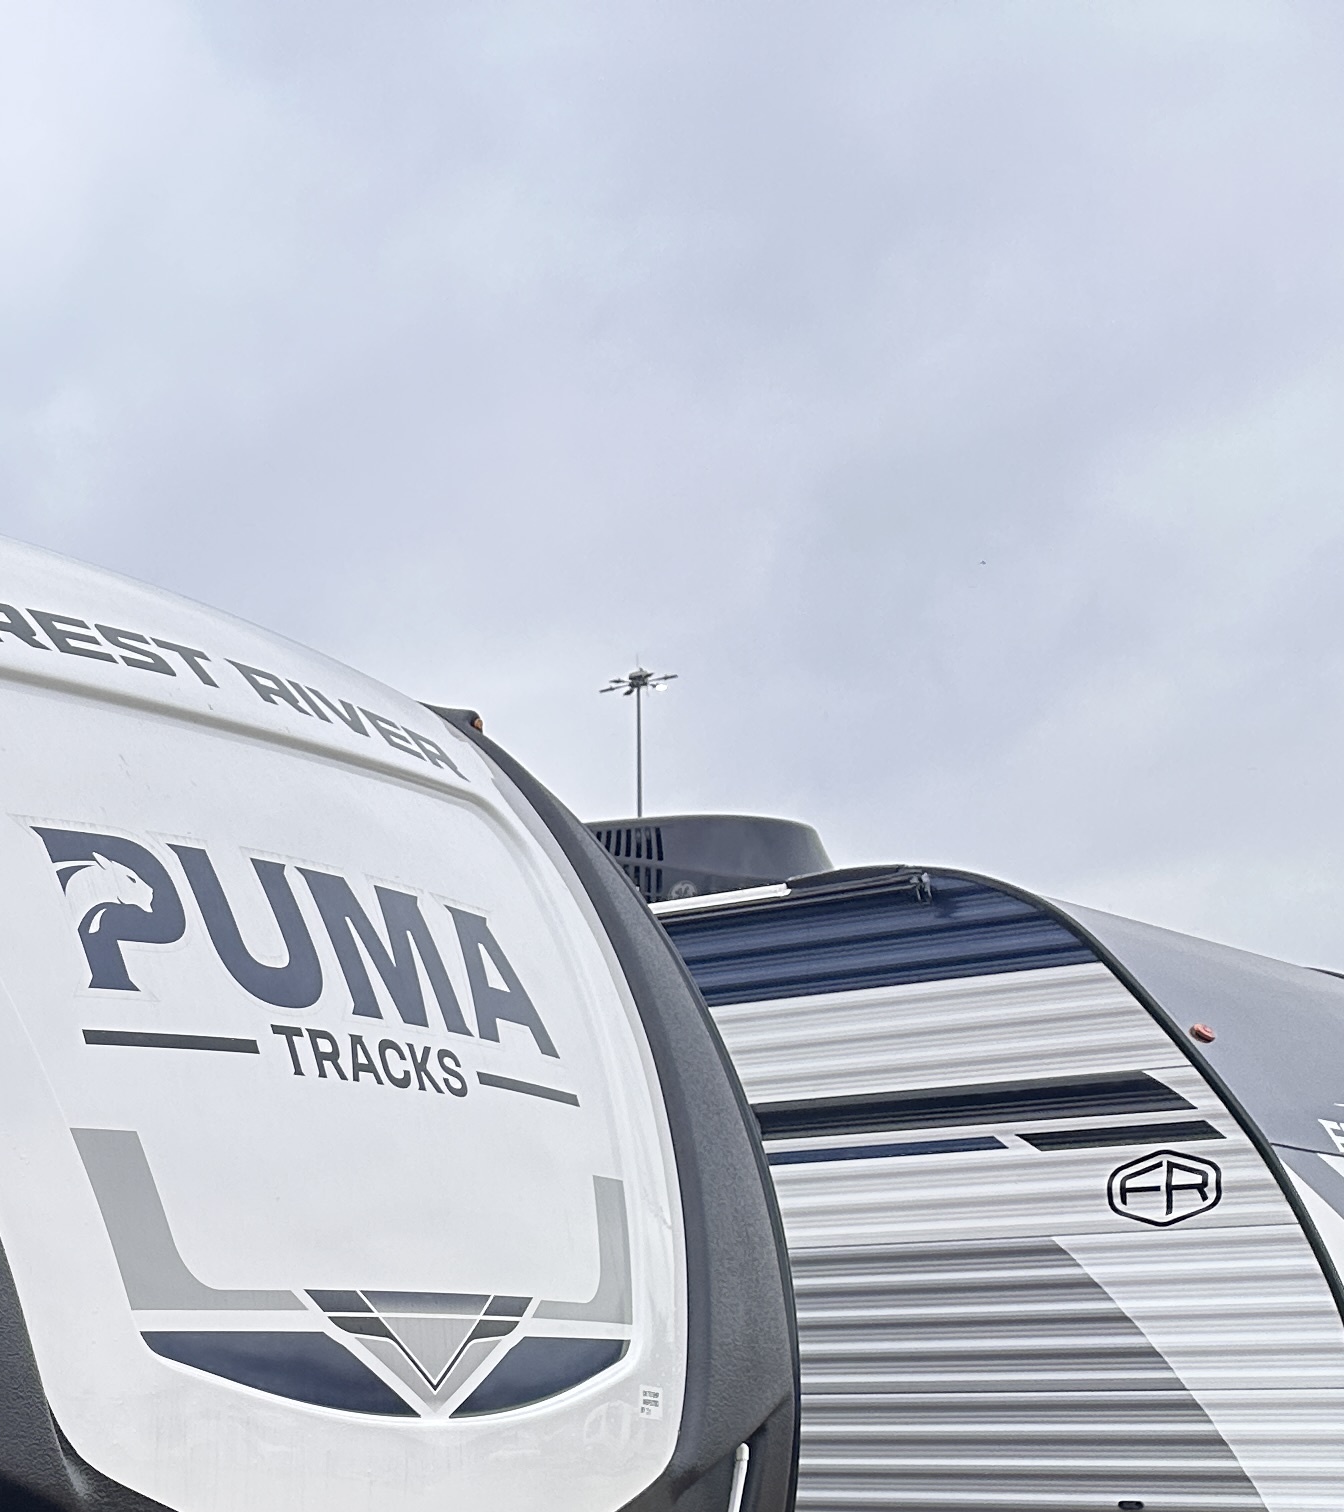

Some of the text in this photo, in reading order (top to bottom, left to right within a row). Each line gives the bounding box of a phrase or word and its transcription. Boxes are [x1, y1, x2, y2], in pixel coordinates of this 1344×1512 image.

[226, 658, 469, 780] RIVER
[32, 826, 561, 1060] PUMA
[269, 1023, 469, 1099] TRACKS
